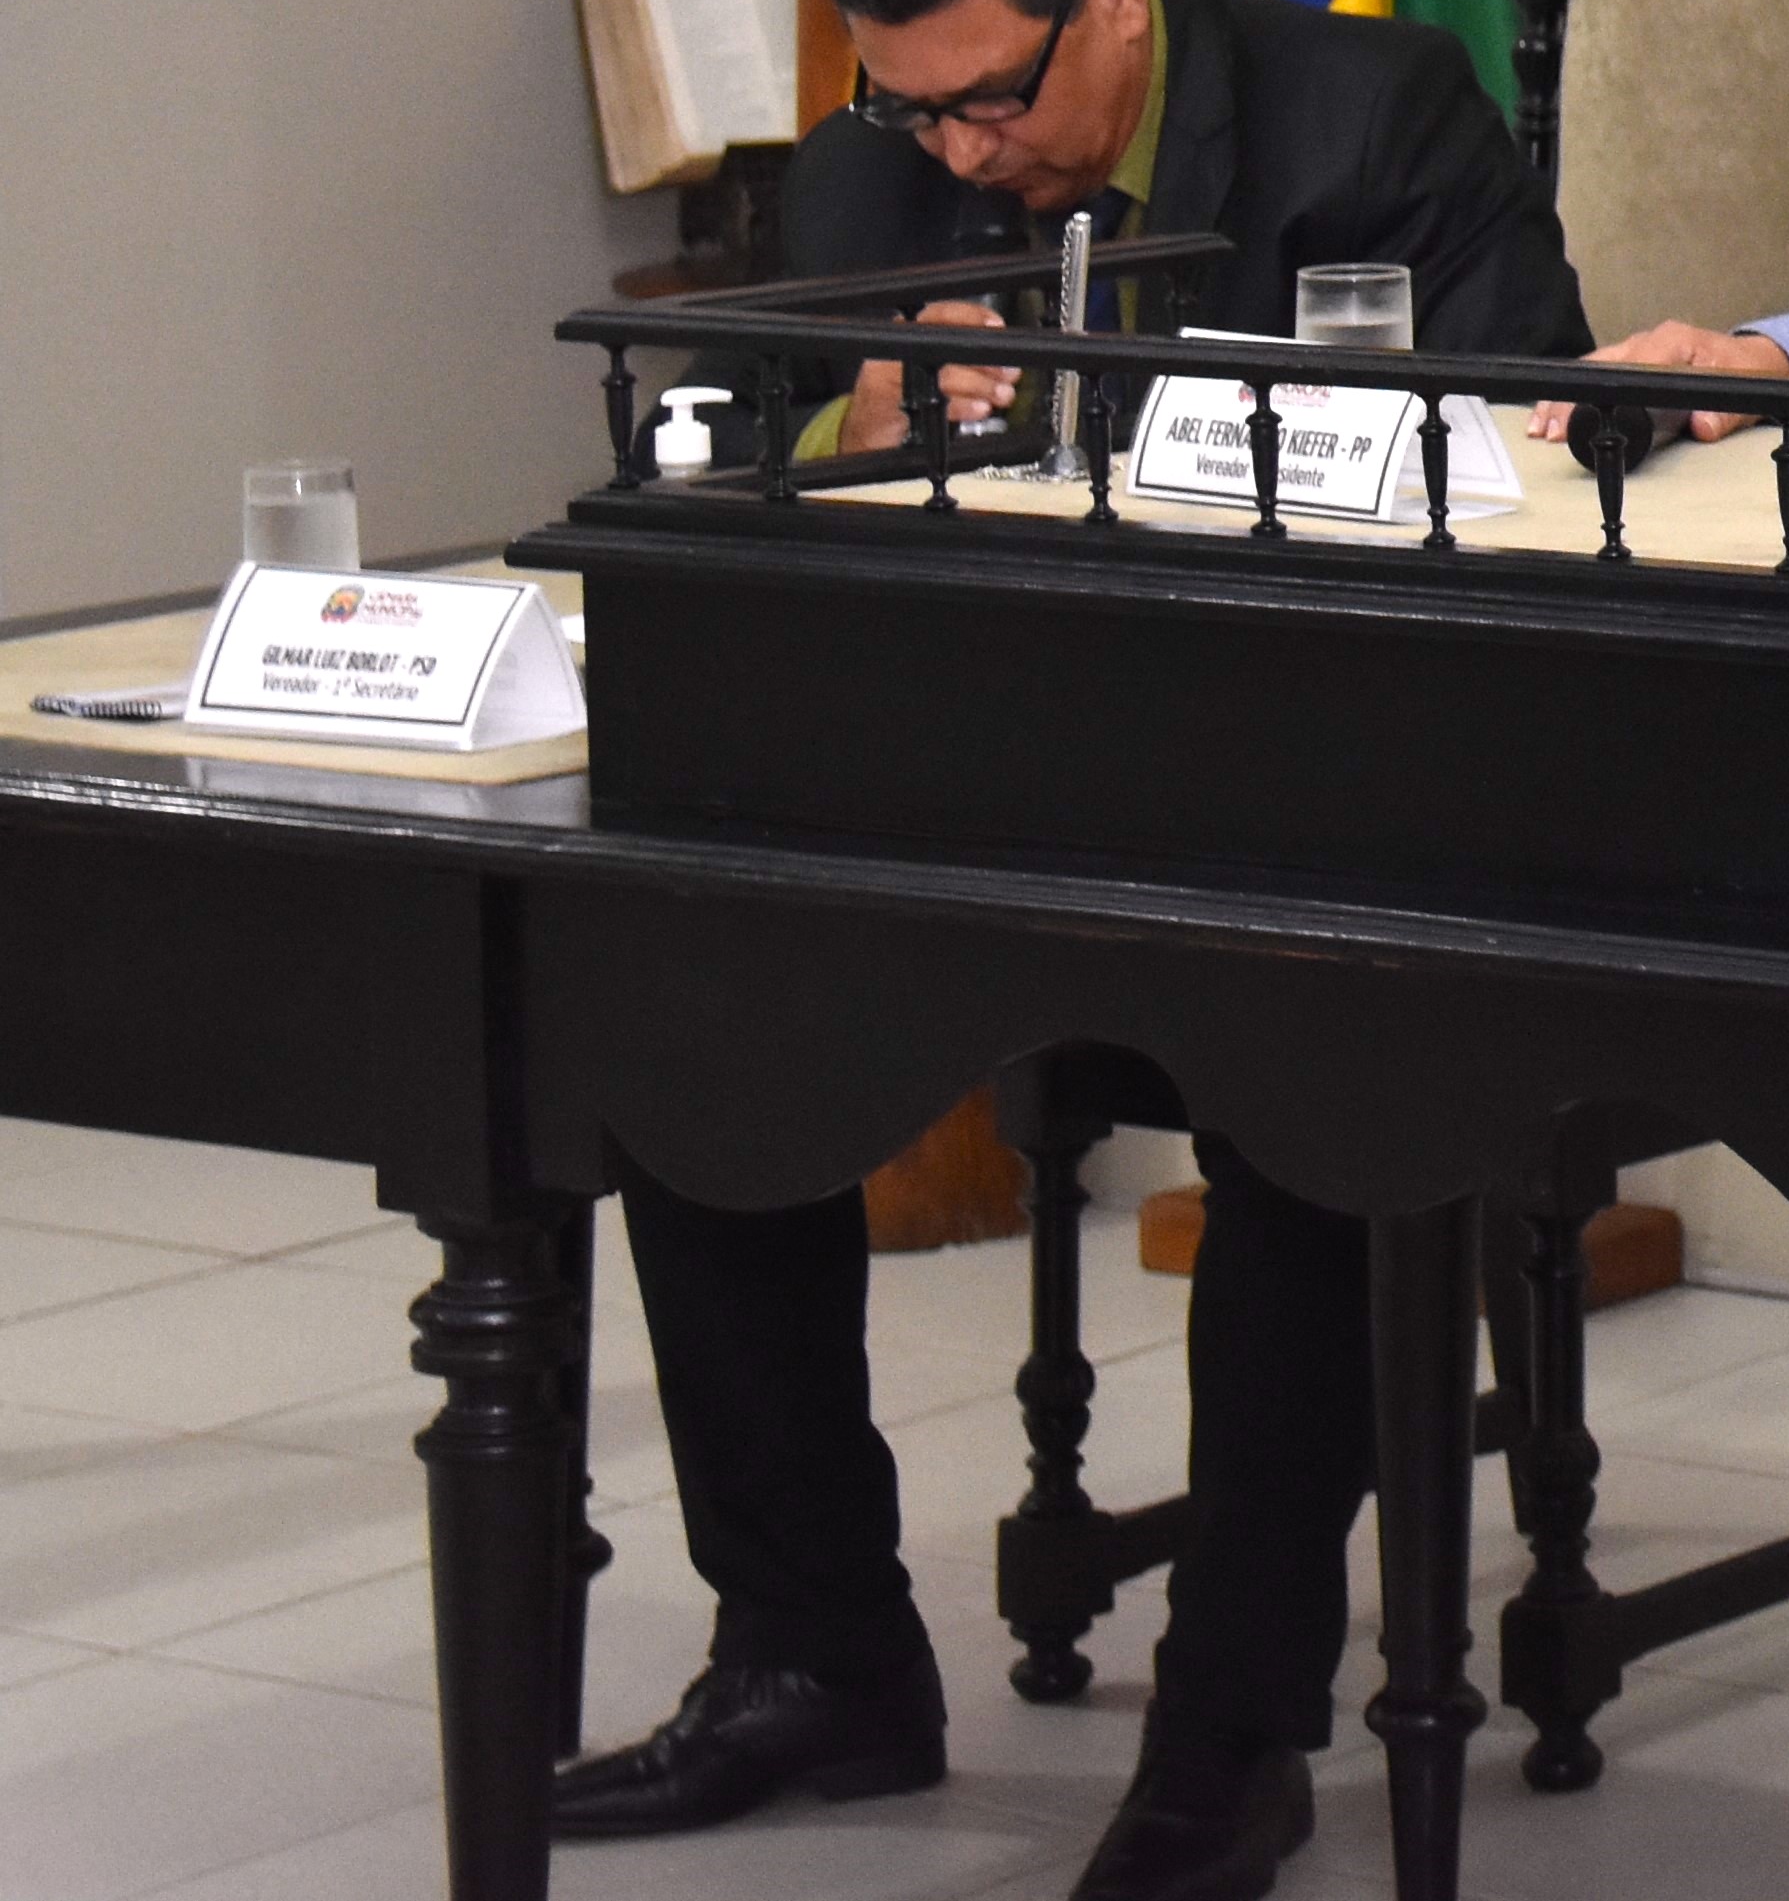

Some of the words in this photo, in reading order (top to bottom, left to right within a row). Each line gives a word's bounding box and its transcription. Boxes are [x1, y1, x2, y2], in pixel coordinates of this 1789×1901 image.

[1165, 415, 1203, 445] ABEL
[1205, 419, 1287, 451] FERNAO
[1287, 428, 1338, 459] KIEFER
[1349, 436, 1372, 463] PP
[1197, 453, 1250, 479] Vereador
[263, 672, 320, 695] Vereador
